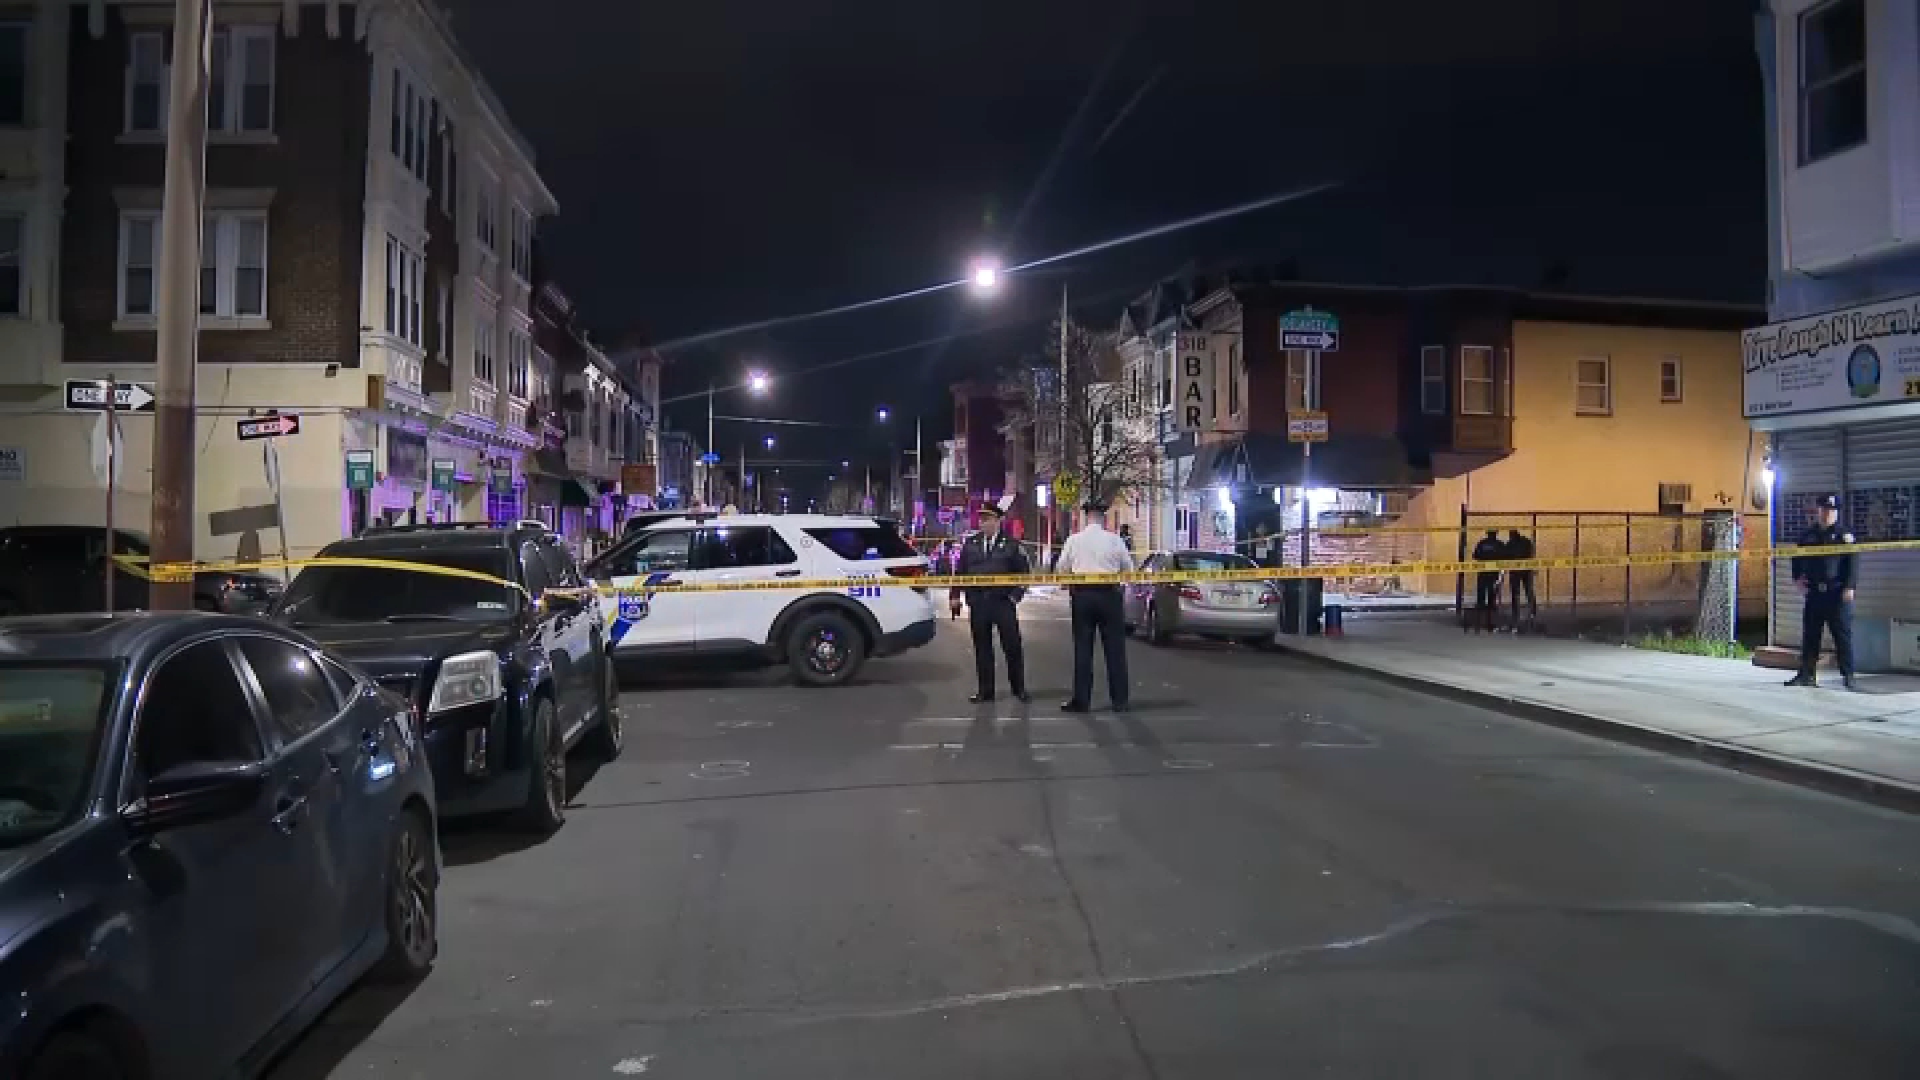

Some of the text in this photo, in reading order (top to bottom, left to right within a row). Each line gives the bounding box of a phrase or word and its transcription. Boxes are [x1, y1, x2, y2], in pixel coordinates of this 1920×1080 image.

[1776, 319, 1830, 359] Laugh
[1832, 313, 1849, 346] N
[1851, 308, 1910, 342] Learn
[1184, 356, 1203, 428] BAR
